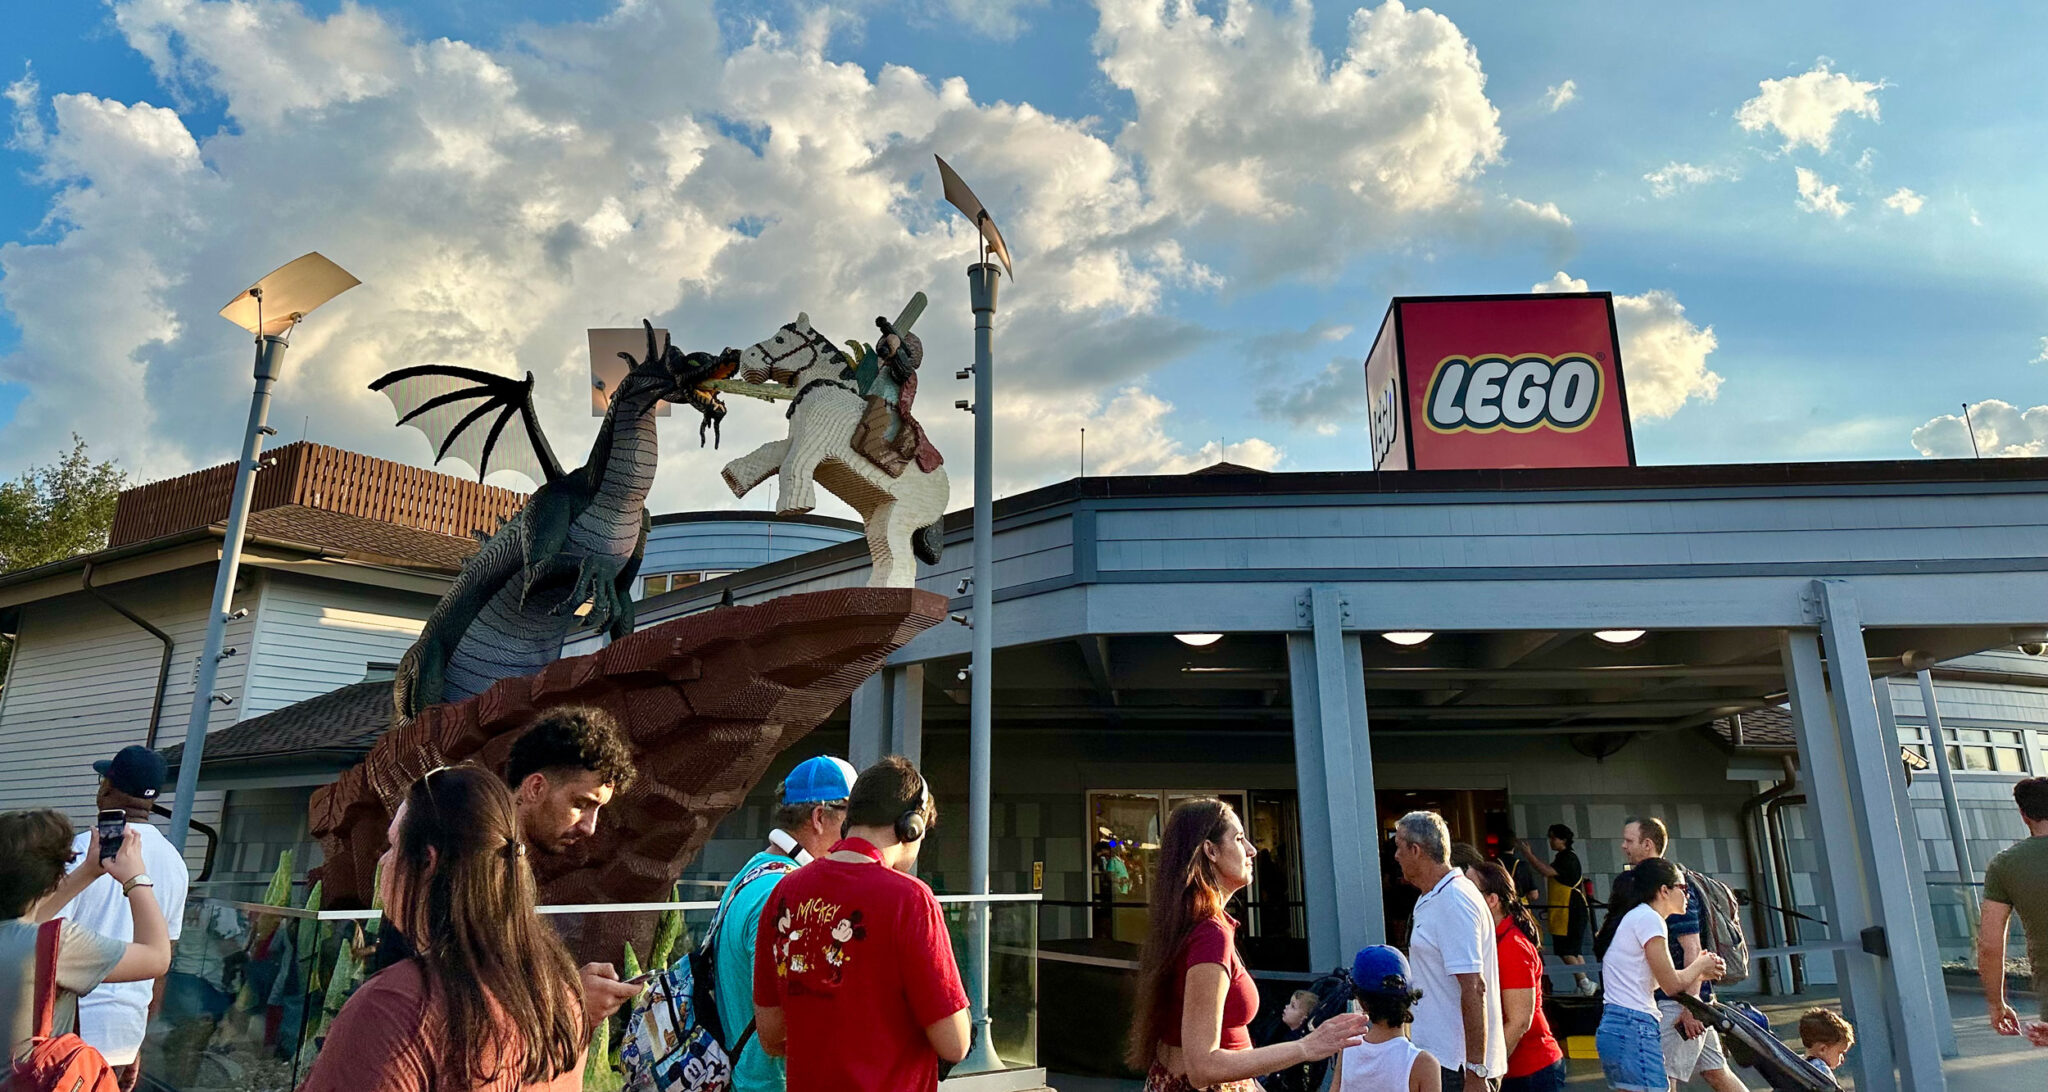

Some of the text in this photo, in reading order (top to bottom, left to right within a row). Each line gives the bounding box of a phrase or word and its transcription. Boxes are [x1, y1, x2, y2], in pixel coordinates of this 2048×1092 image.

[1373, 378, 1397, 471] LEGO
[1428, 356, 1600, 429] LEGO
[796, 897, 842, 924] MICKEY
